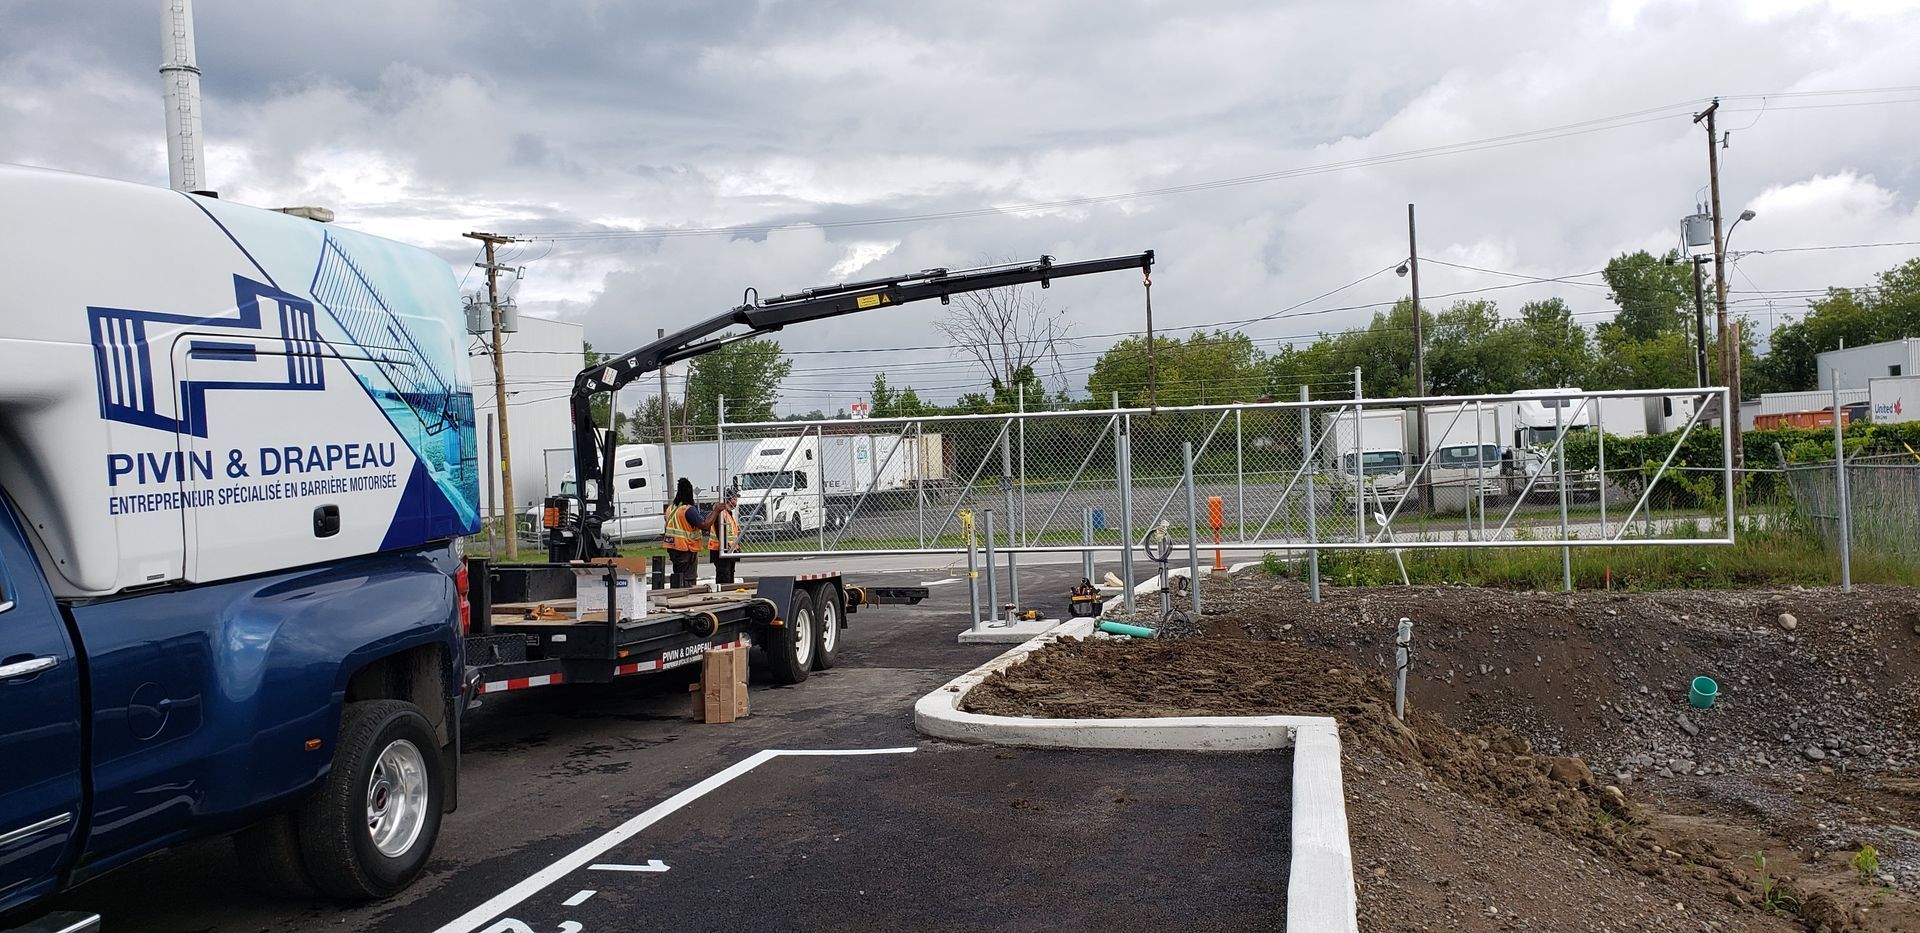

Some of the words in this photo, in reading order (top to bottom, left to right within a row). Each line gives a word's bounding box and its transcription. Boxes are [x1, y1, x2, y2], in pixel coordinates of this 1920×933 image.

[1874, 402, 1893, 414] United
[107, 450, 214, 487] PIVIN
[226, 448, 250, 479] &
[260, 442, 396, 476] DRAPEAU
[109, 489, 215, 515] ENTREPRENEUR
[218, 480, 281, 505] SPÉCIALISÉ
[284, 482, 298, 499] EN
[300, 475, 348, 497] BARRIÈRE
[349, 470, 397, 492] MOTORISÉE
[662, 649, 679, 663] PIVIN
[685, 641, 712, 657] DRAPEAU
